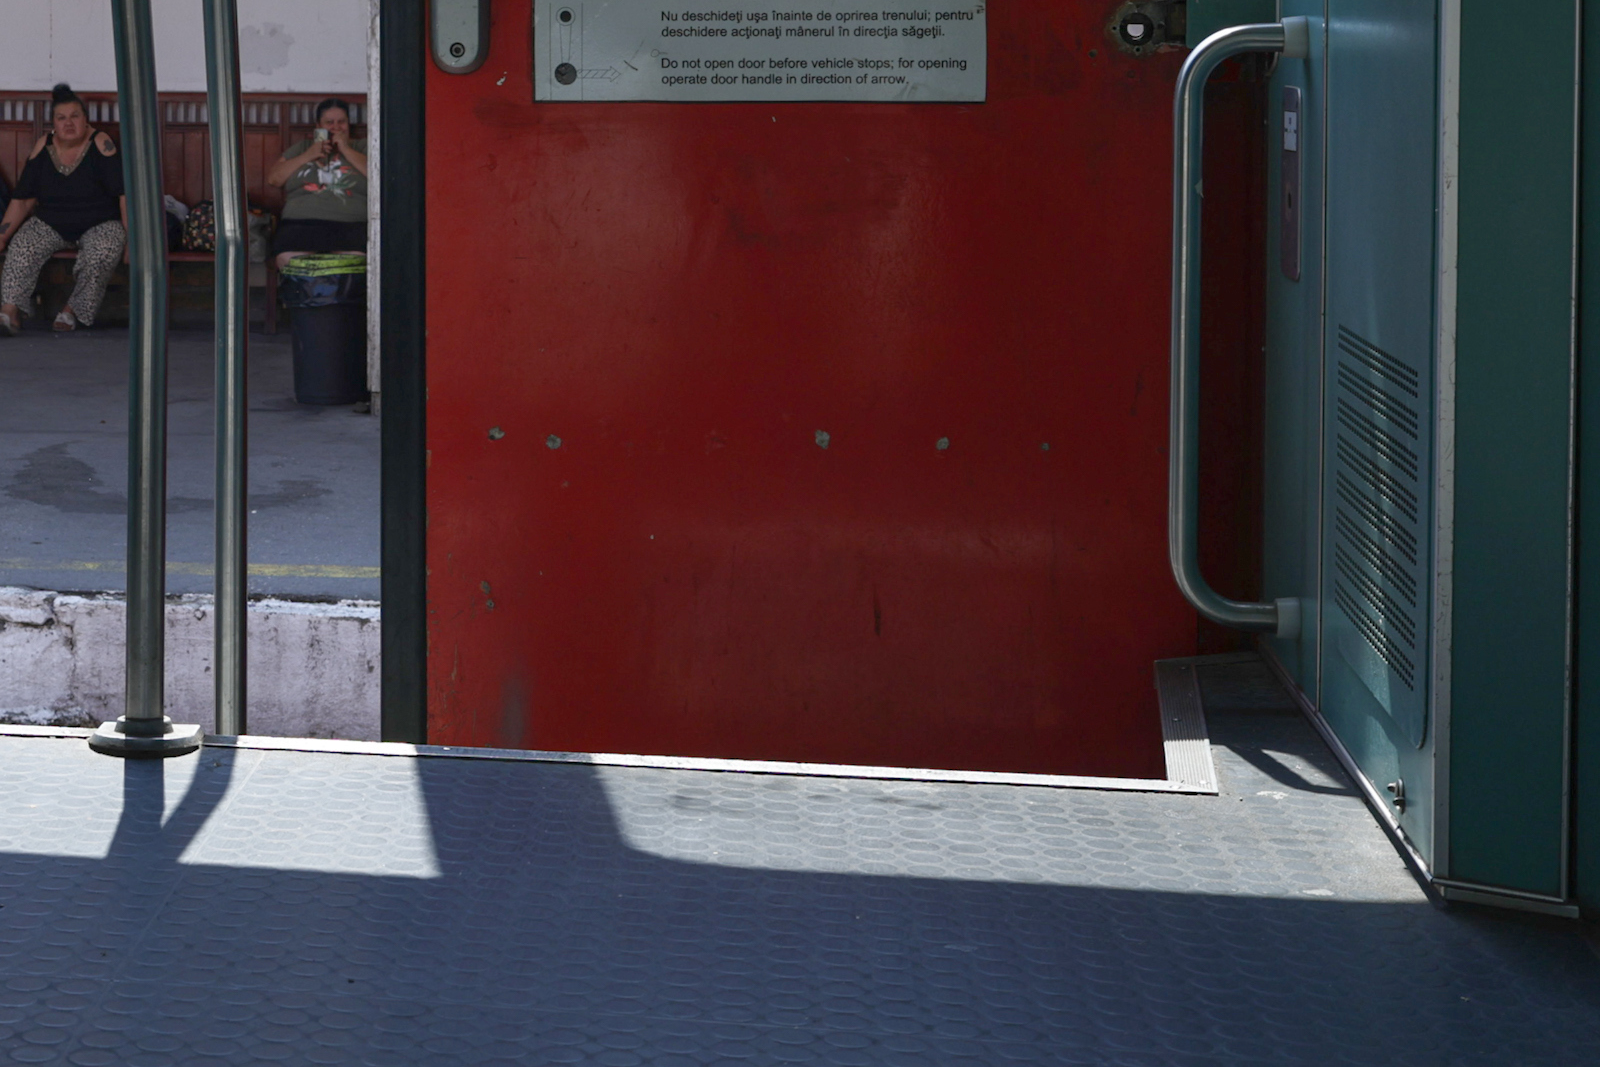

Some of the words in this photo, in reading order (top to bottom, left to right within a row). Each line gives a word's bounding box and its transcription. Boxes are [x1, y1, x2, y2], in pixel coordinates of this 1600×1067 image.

[660, 10, 679, 22] Nu
[771, 9, 814, 22] înainte
[816, 9, 833, 22] de
[835, 9, 879, 24] oprirea
[881, 9, 931, 23] trenului;
[934, 10, 974, 24] pentru
[660, 25, 728, 38] deschidere
[785, 25, 835, 38] mânerul
[837, 25, 850, 38] în
[660, 57, 679, 69] Do
[681, 57, 702, 70] not
[703, 59, 735, 72] open
[737, 57, 767, 70] door
[768, 57, 808, 70] before
[810, 57, 855, 70] vehicle
[856, 58, 895, 72] stops;
[897, 57, 915, 69] for
[917, 57, 968, 72] opening
[661, 73, 708, 87] operate
[710, 73, 739, 85] door
[741, 73, 784, 85] handle
[785, 73, 797, 85] in
[799, 73, 853, 85] direction
[855, 73, 869, 85] of
[870, 75, 910, 86] arrow.
